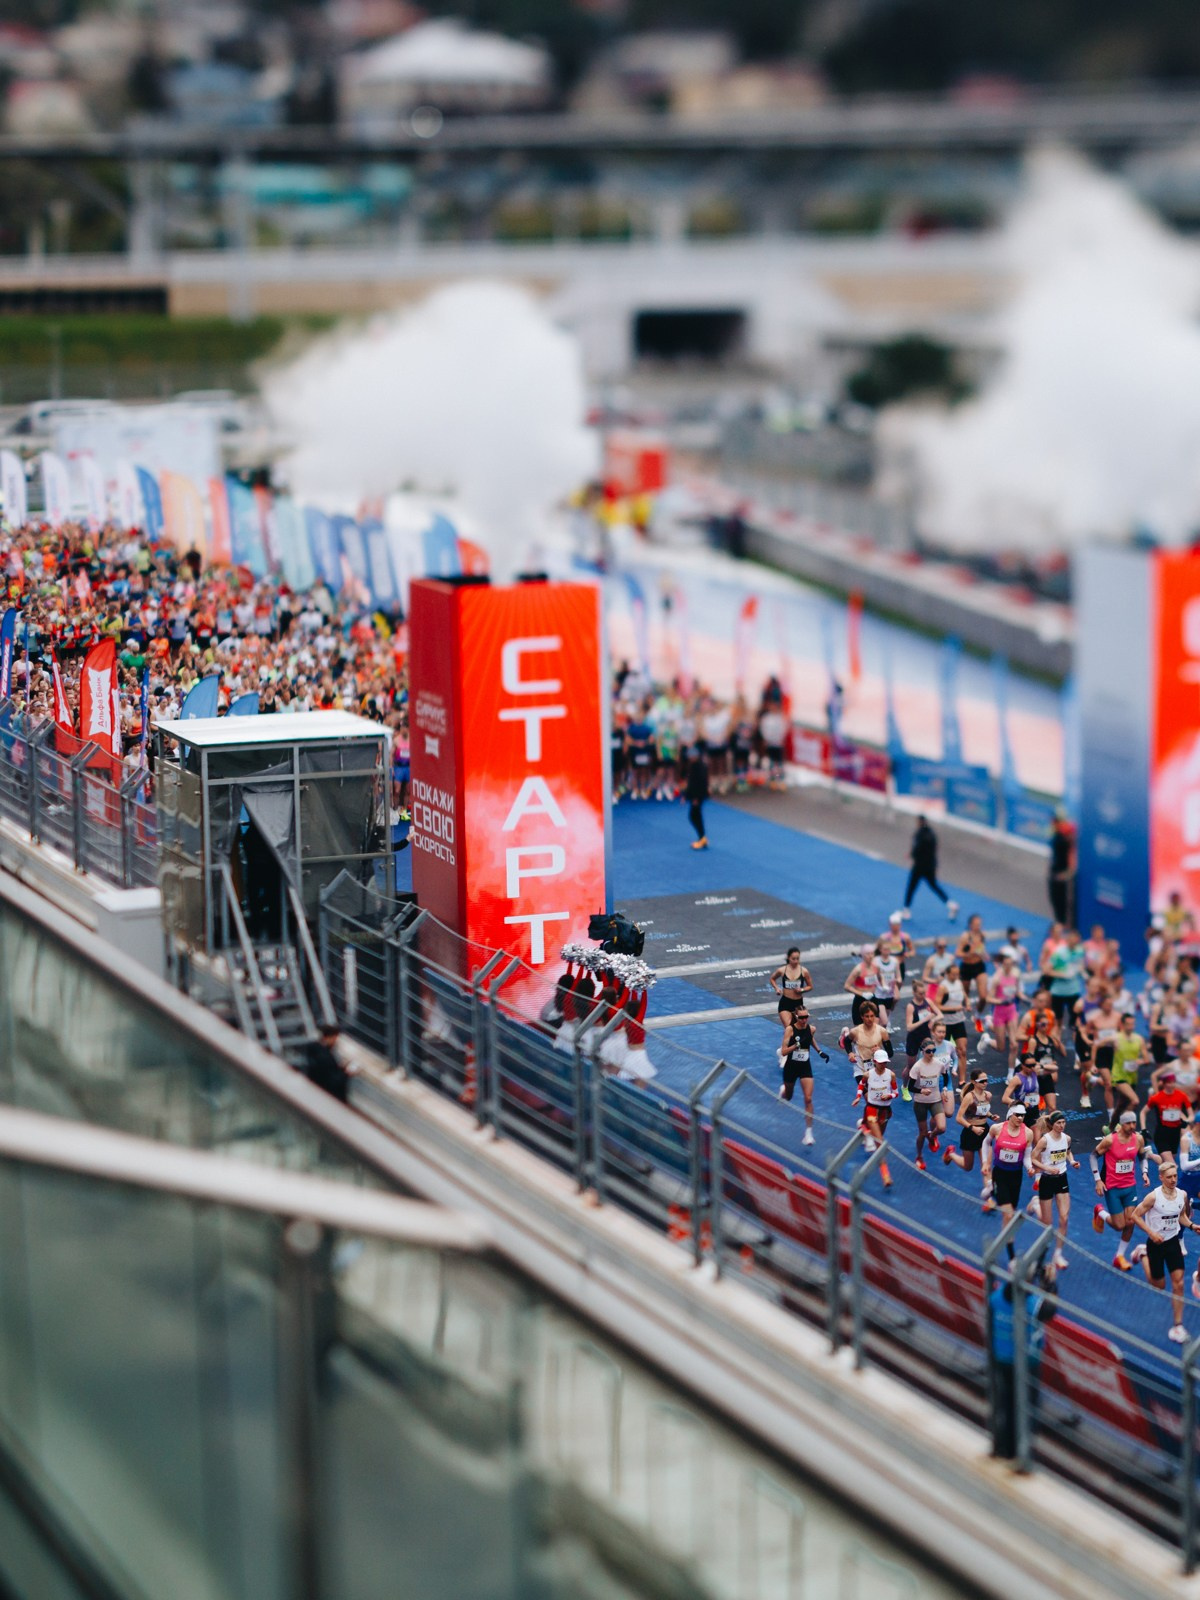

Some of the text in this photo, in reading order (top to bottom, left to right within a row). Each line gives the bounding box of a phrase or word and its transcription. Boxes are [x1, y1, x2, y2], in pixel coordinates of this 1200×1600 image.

[97, 699, 105, 728] Альфа
[412, 778, 454, 814] ПОКАЖИ
[498, 635, 570, 965] СТАРТ
[413, 801, 454, 844] СВОЮ
[413, 832, 455, 866] СКОРОСТЬ
